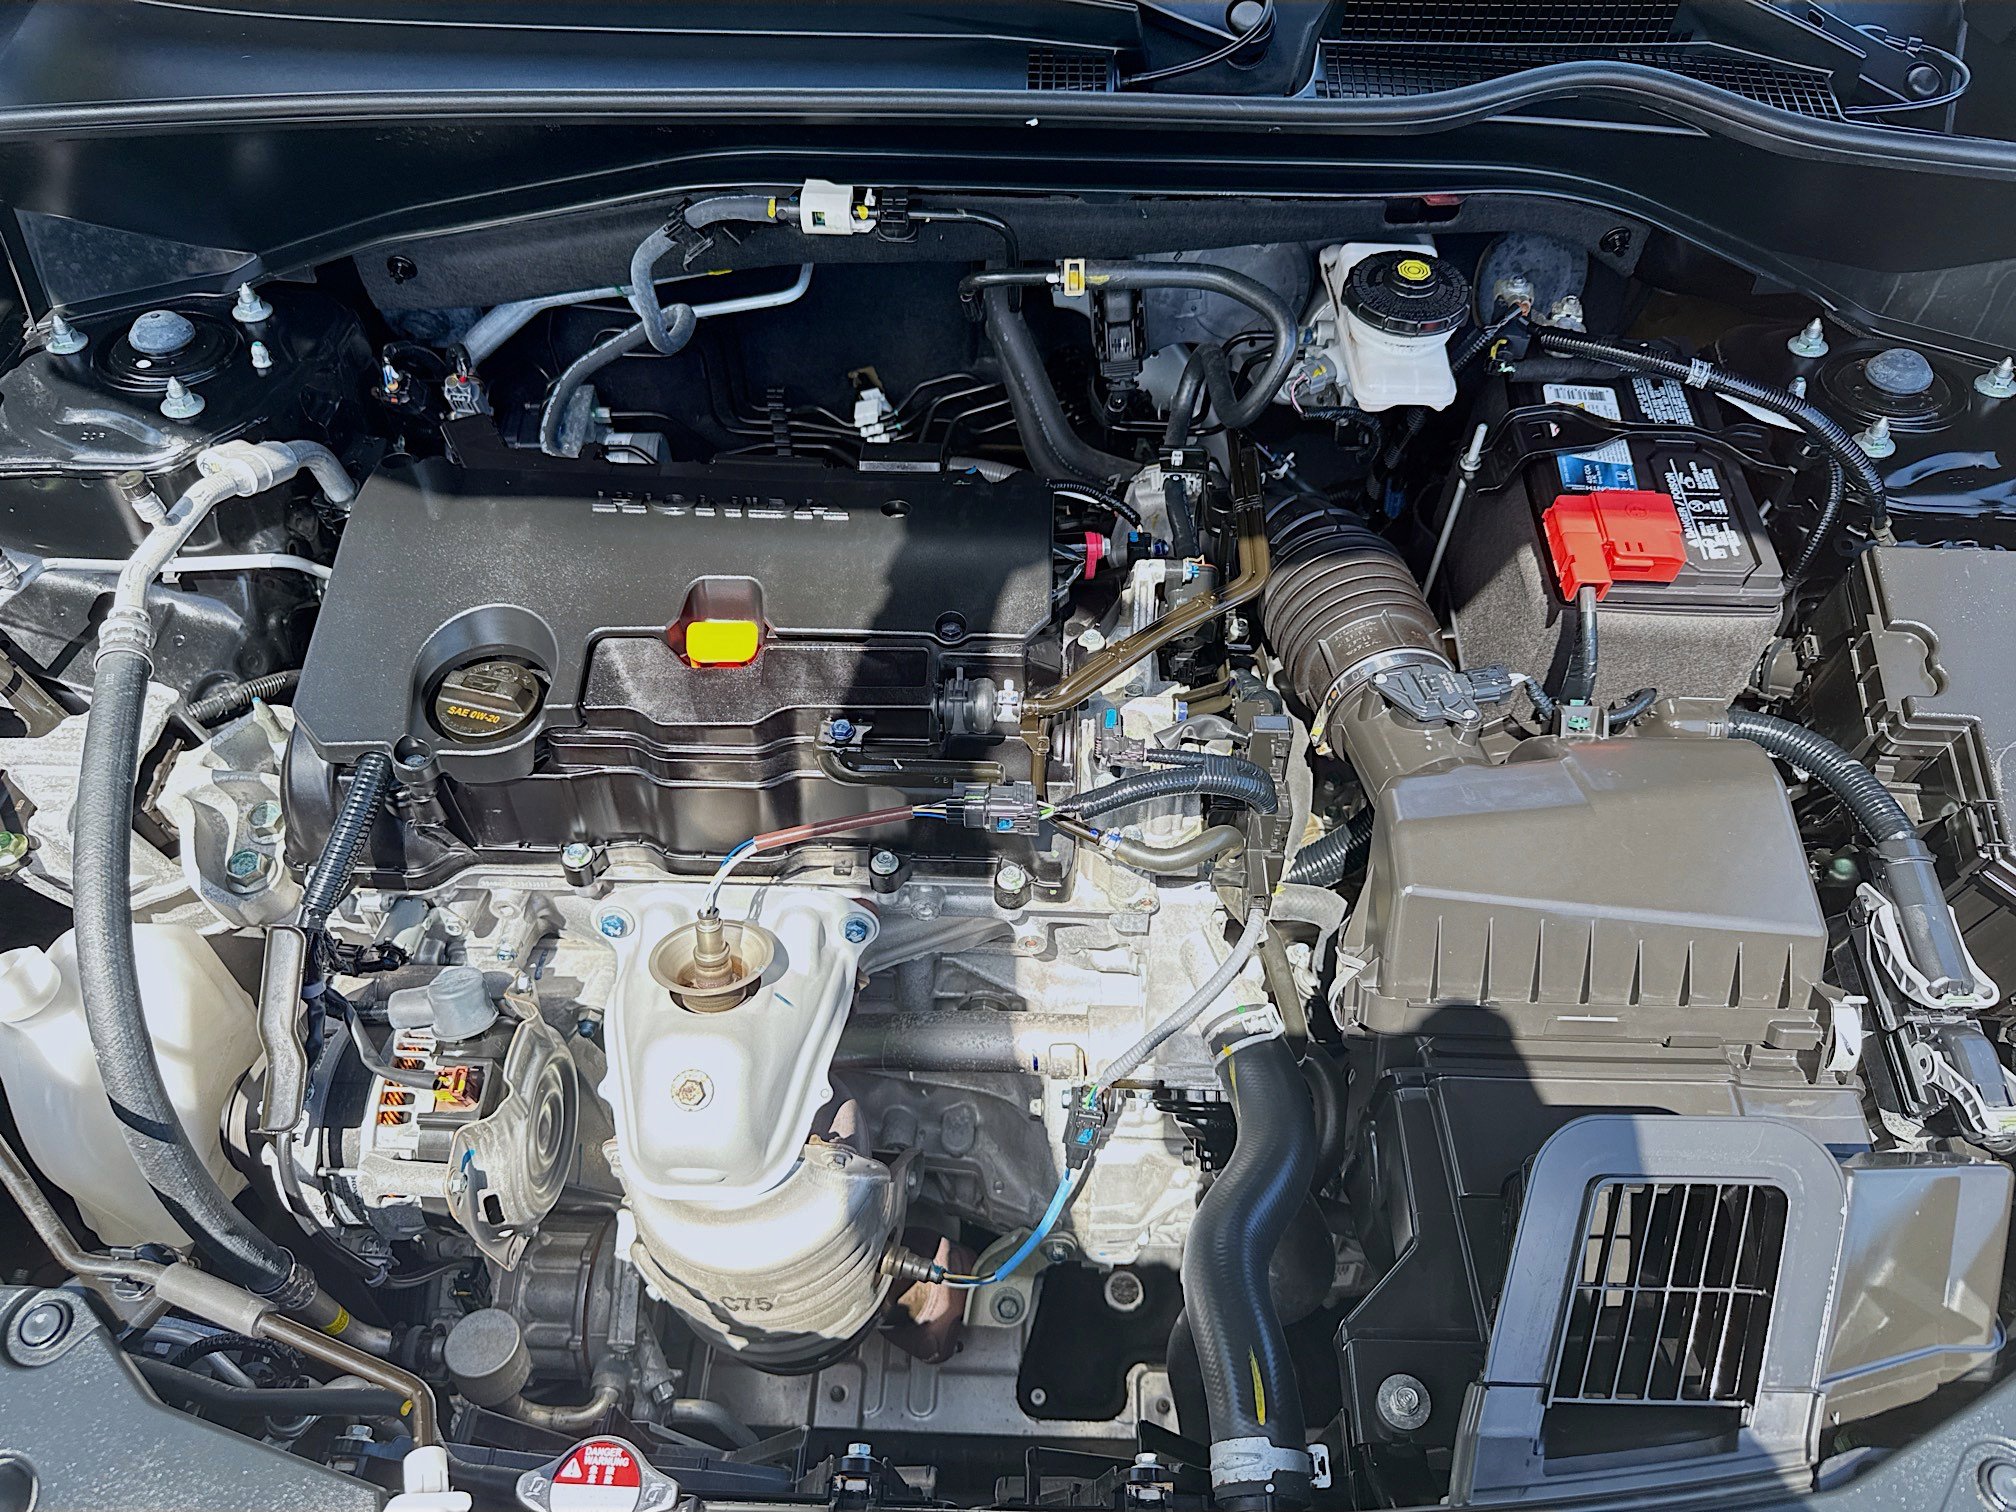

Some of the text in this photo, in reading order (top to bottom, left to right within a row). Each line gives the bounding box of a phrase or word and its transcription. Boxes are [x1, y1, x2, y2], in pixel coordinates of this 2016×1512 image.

[447, 706, 501, 724] SAE 0W-20
[585, 1446, 623, 1457] DANGER
